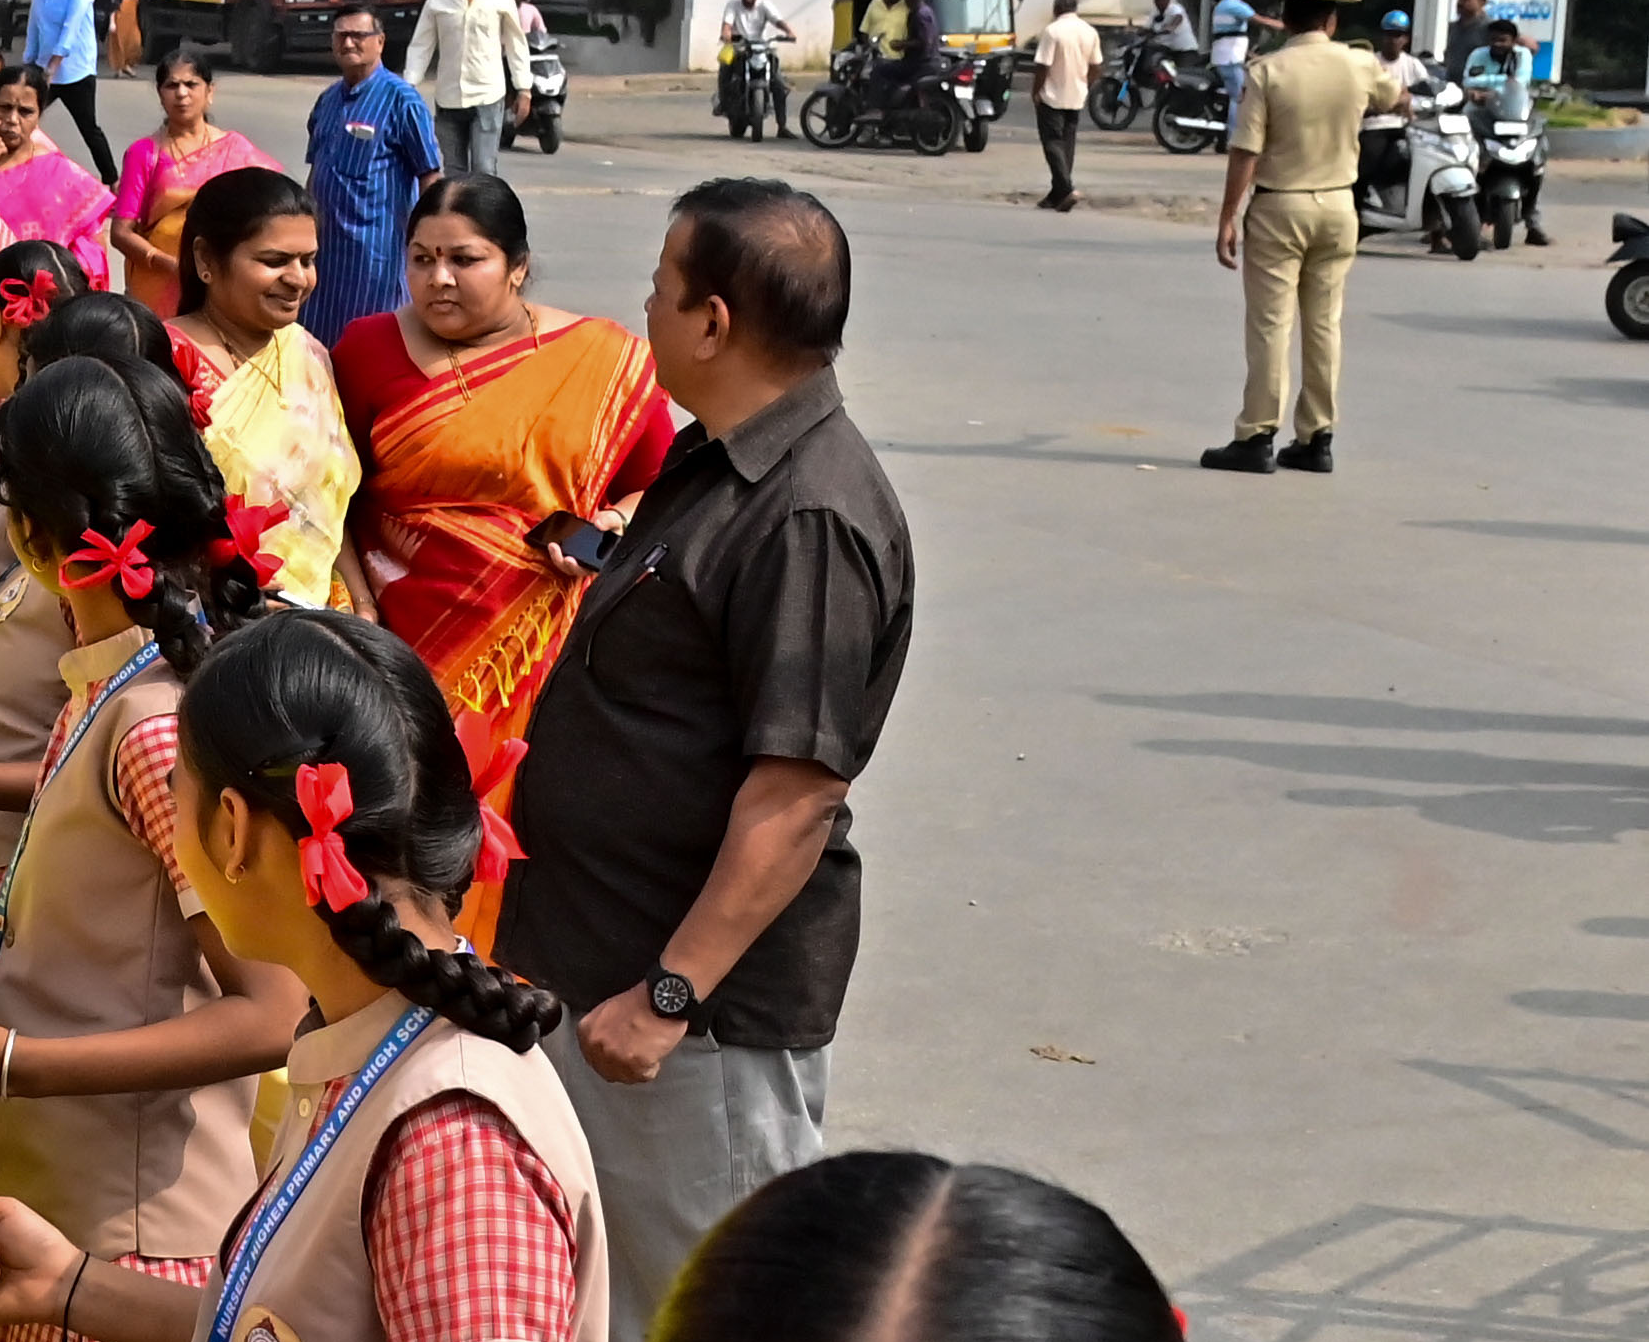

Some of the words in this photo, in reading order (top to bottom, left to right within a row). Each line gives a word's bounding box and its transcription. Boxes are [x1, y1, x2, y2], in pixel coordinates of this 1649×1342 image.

[109, 662, 137, 695] HIGH
[135, 642, 161, 667] SCH
[215, 1265, 252, 1340] NURSERY
[250, 1196, 289, 1261] HIGHER
[285, 1124, 339, 1198] PRIMARY
[334, 1083, 365, 1124] AND
[361, 1039, 401, 1089] HIGH
[395, 1005, 435, 1048] SCH
